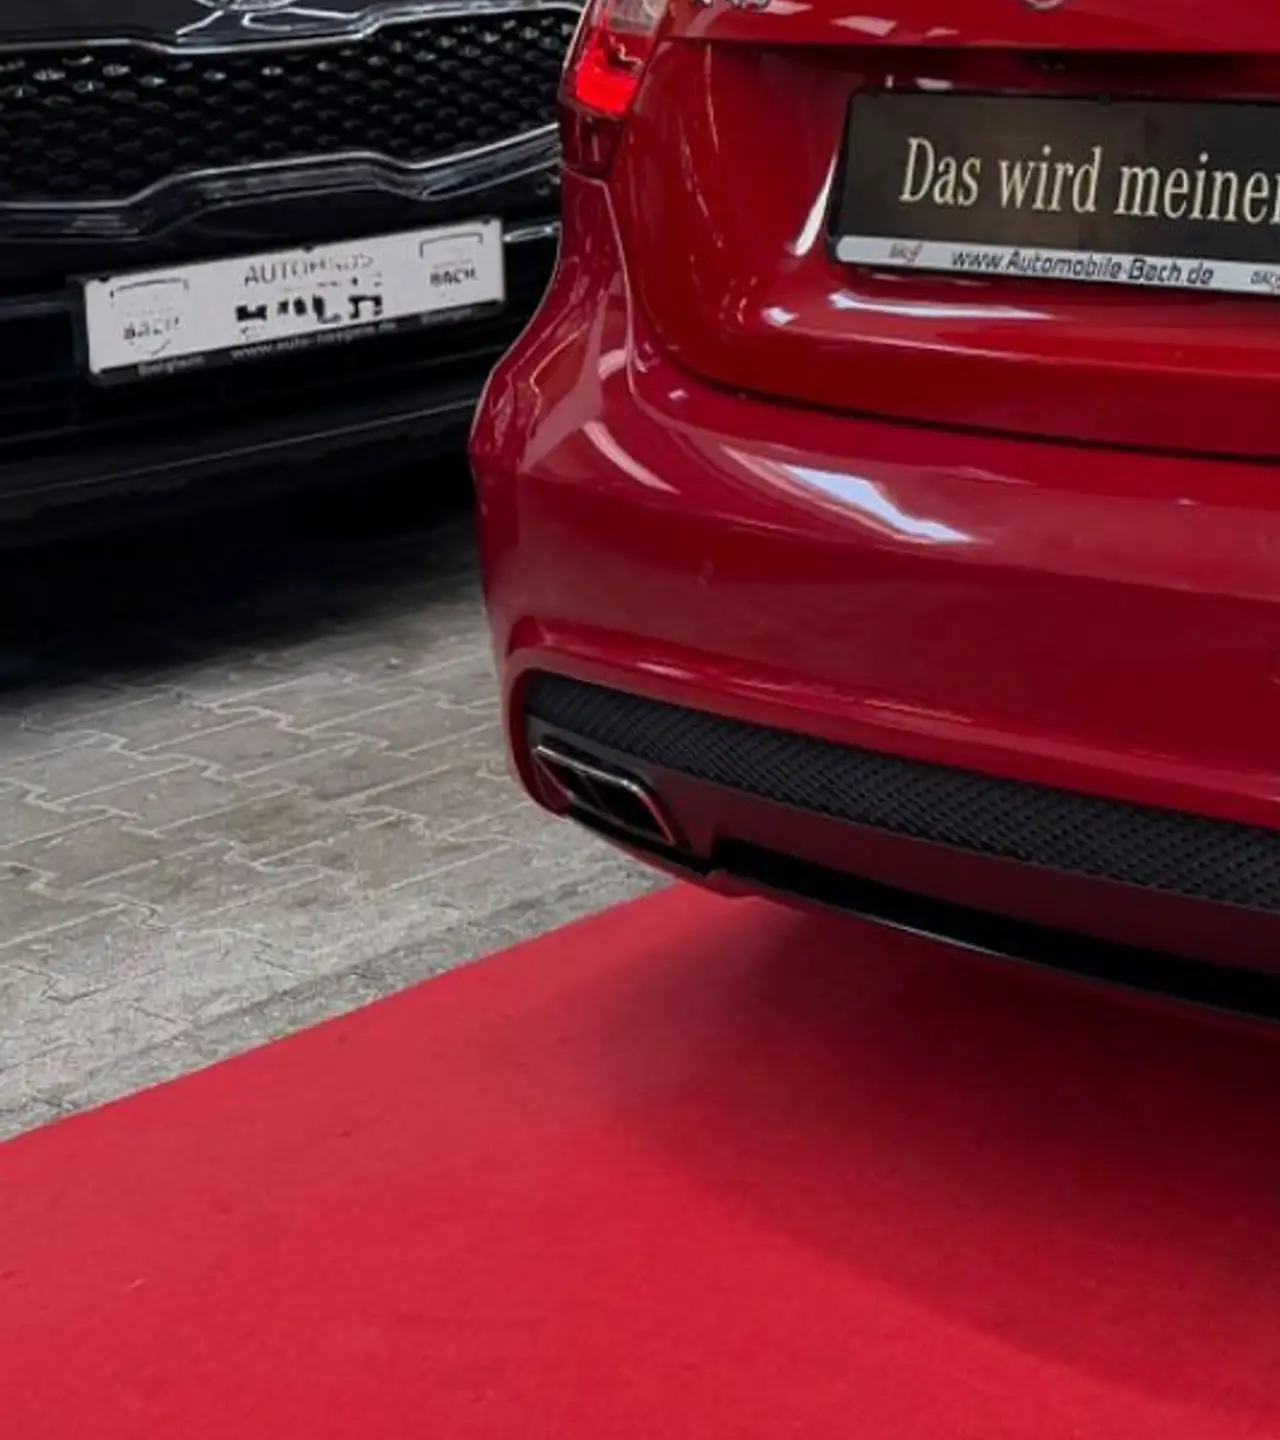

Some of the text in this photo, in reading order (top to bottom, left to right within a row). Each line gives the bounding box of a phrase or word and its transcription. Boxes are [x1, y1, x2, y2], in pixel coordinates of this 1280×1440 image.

[899, 136, 981, 207] Das
[999, 145, 1104, 214] wird
[951, 248, 1215, 287] www.Automobile-Bach.de
